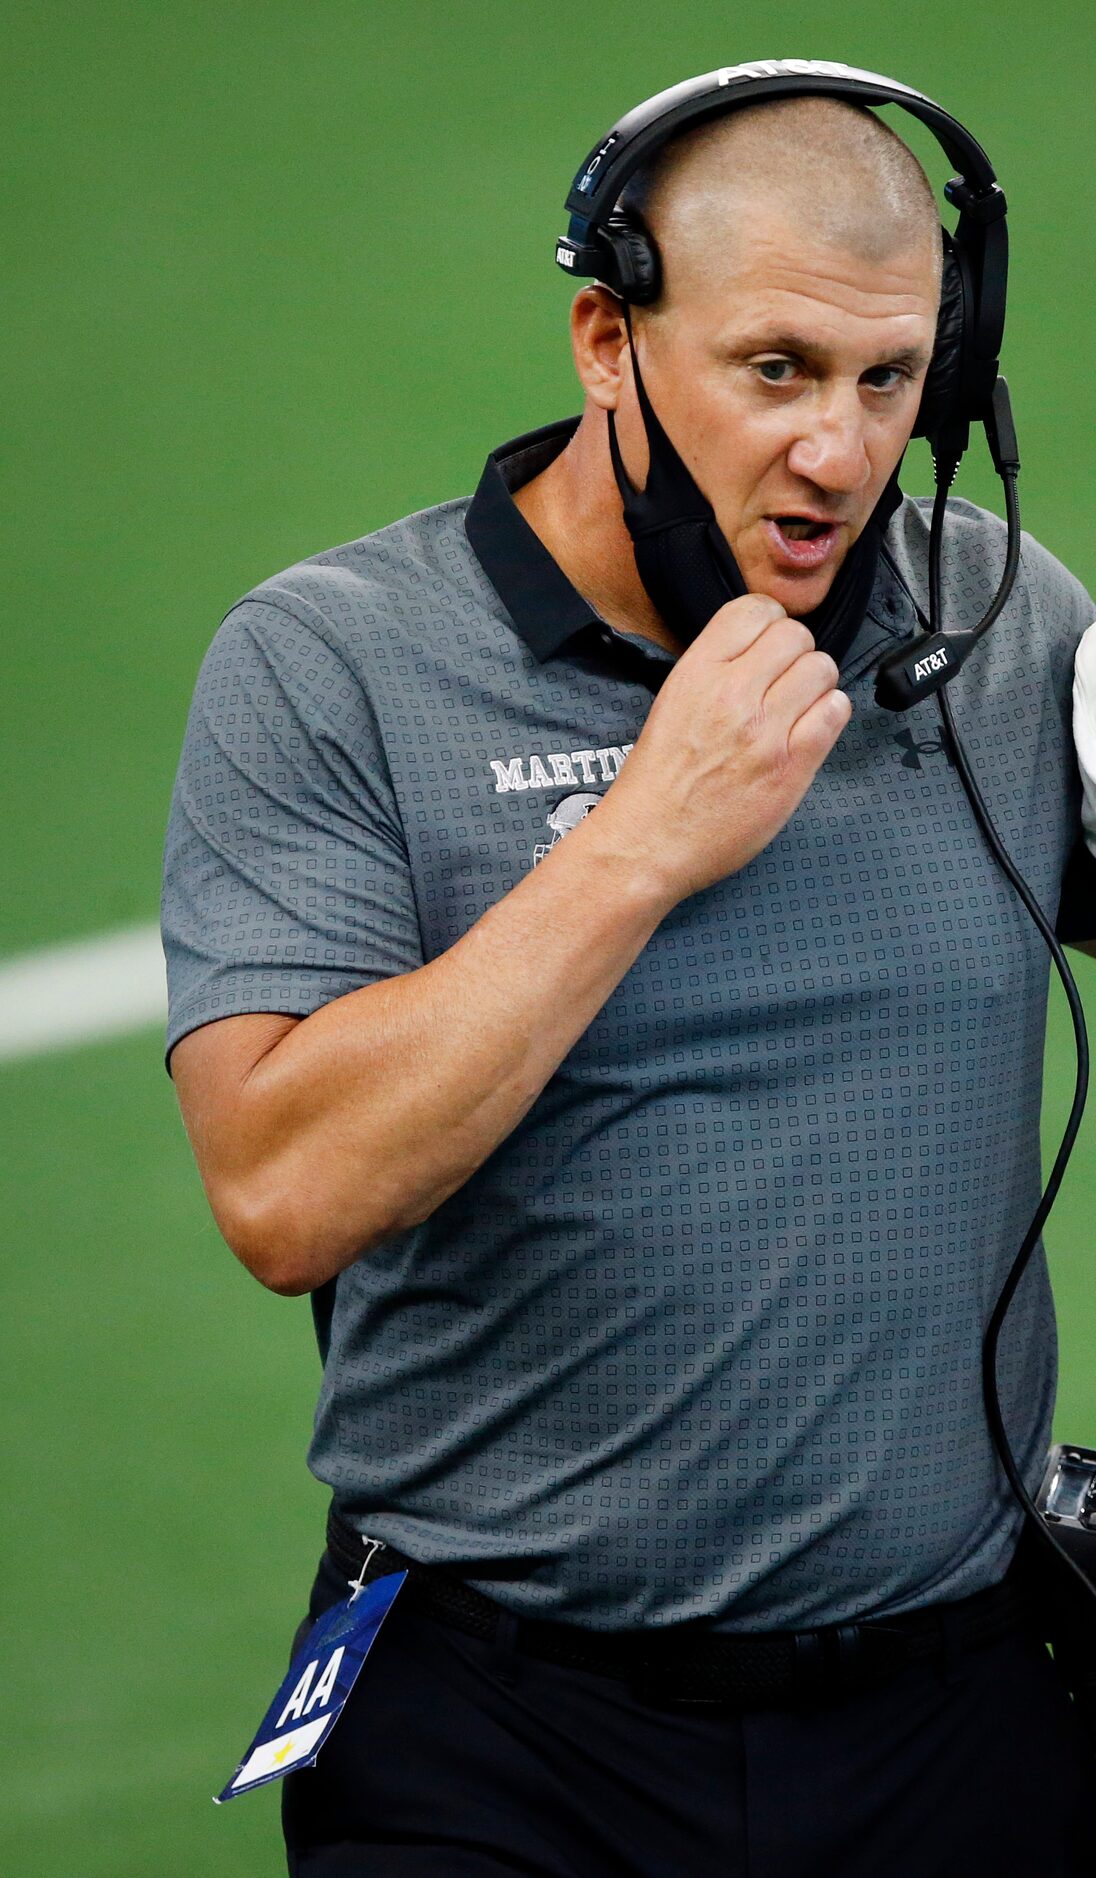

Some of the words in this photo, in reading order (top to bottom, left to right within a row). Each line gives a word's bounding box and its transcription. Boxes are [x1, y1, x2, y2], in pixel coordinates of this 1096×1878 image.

[718, 59, 850, 87] AT&T
[556, 247, 576, 268] AT&T
[914, 647, 948, 681] AT&T
[275, 1645, 346, 1729] AA
